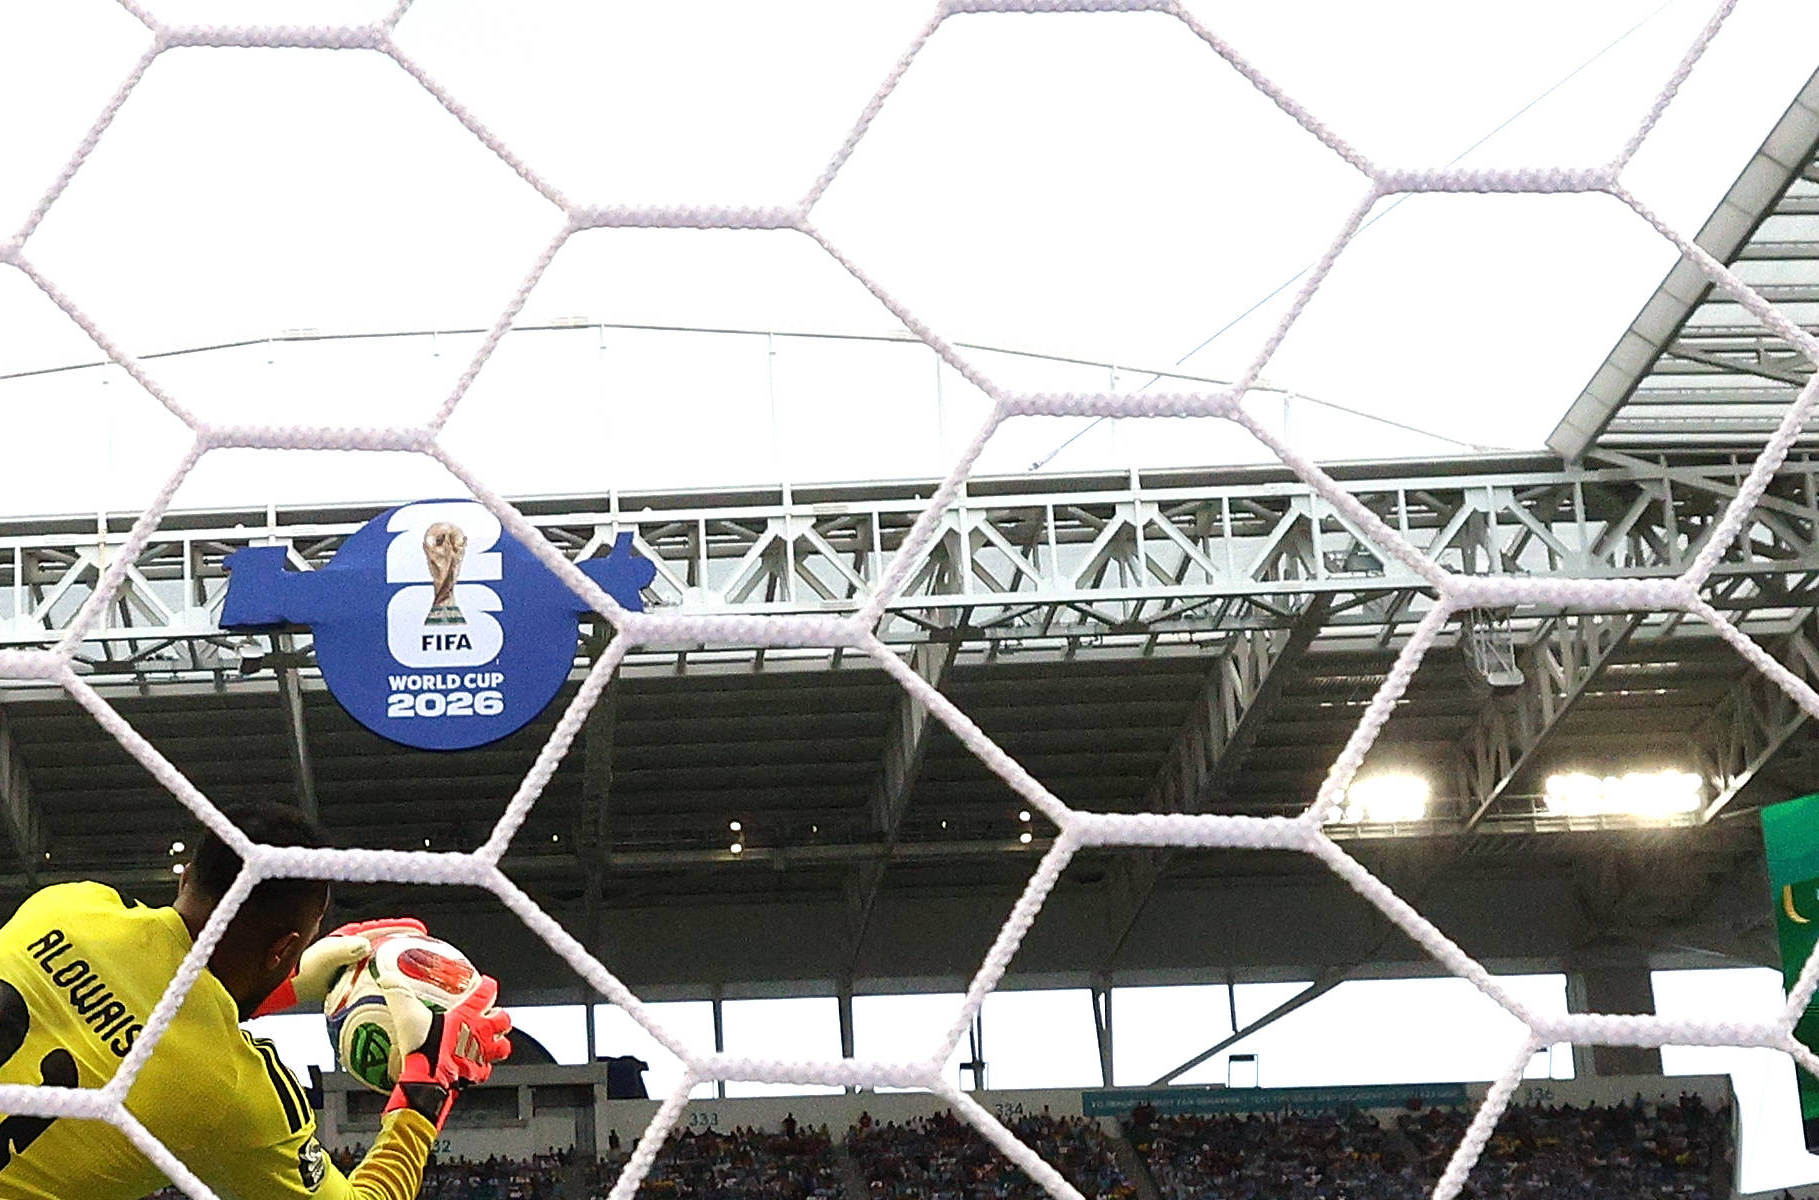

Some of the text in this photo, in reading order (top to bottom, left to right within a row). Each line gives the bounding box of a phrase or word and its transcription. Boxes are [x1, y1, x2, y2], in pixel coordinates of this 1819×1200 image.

[422, 634, 472, 651] FIFA
[388, 672, 504, 690] WORLD CUP
[387, 691, 504, 717] 2026
[27, 929, 145, 1058] ALOWAIS
